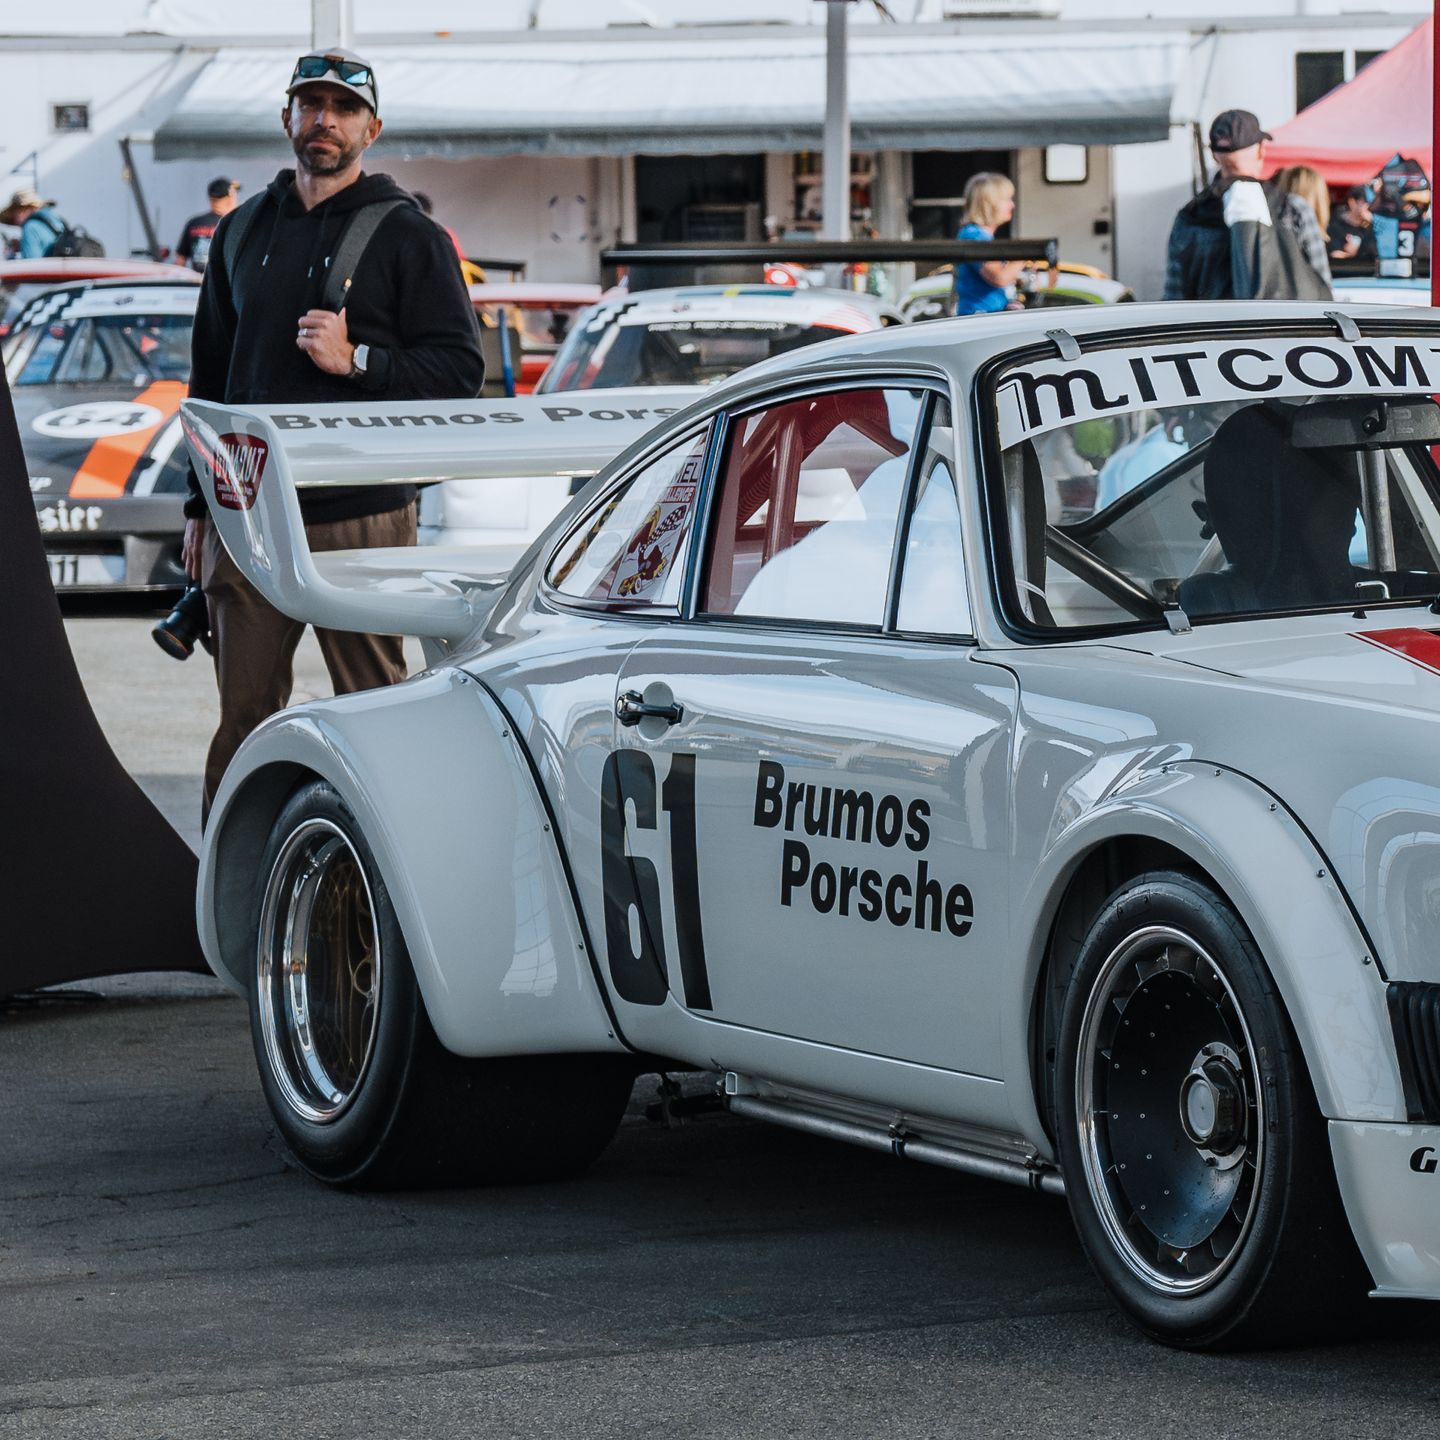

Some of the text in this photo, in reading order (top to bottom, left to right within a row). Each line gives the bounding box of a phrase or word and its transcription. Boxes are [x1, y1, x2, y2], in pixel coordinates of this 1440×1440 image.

[269, 409, 524, 431] Brumos
[752, 759, 932, 853] Brumos
[600, 748, 714, 1011] 61
[780, 839, 975, 938] Porsche
